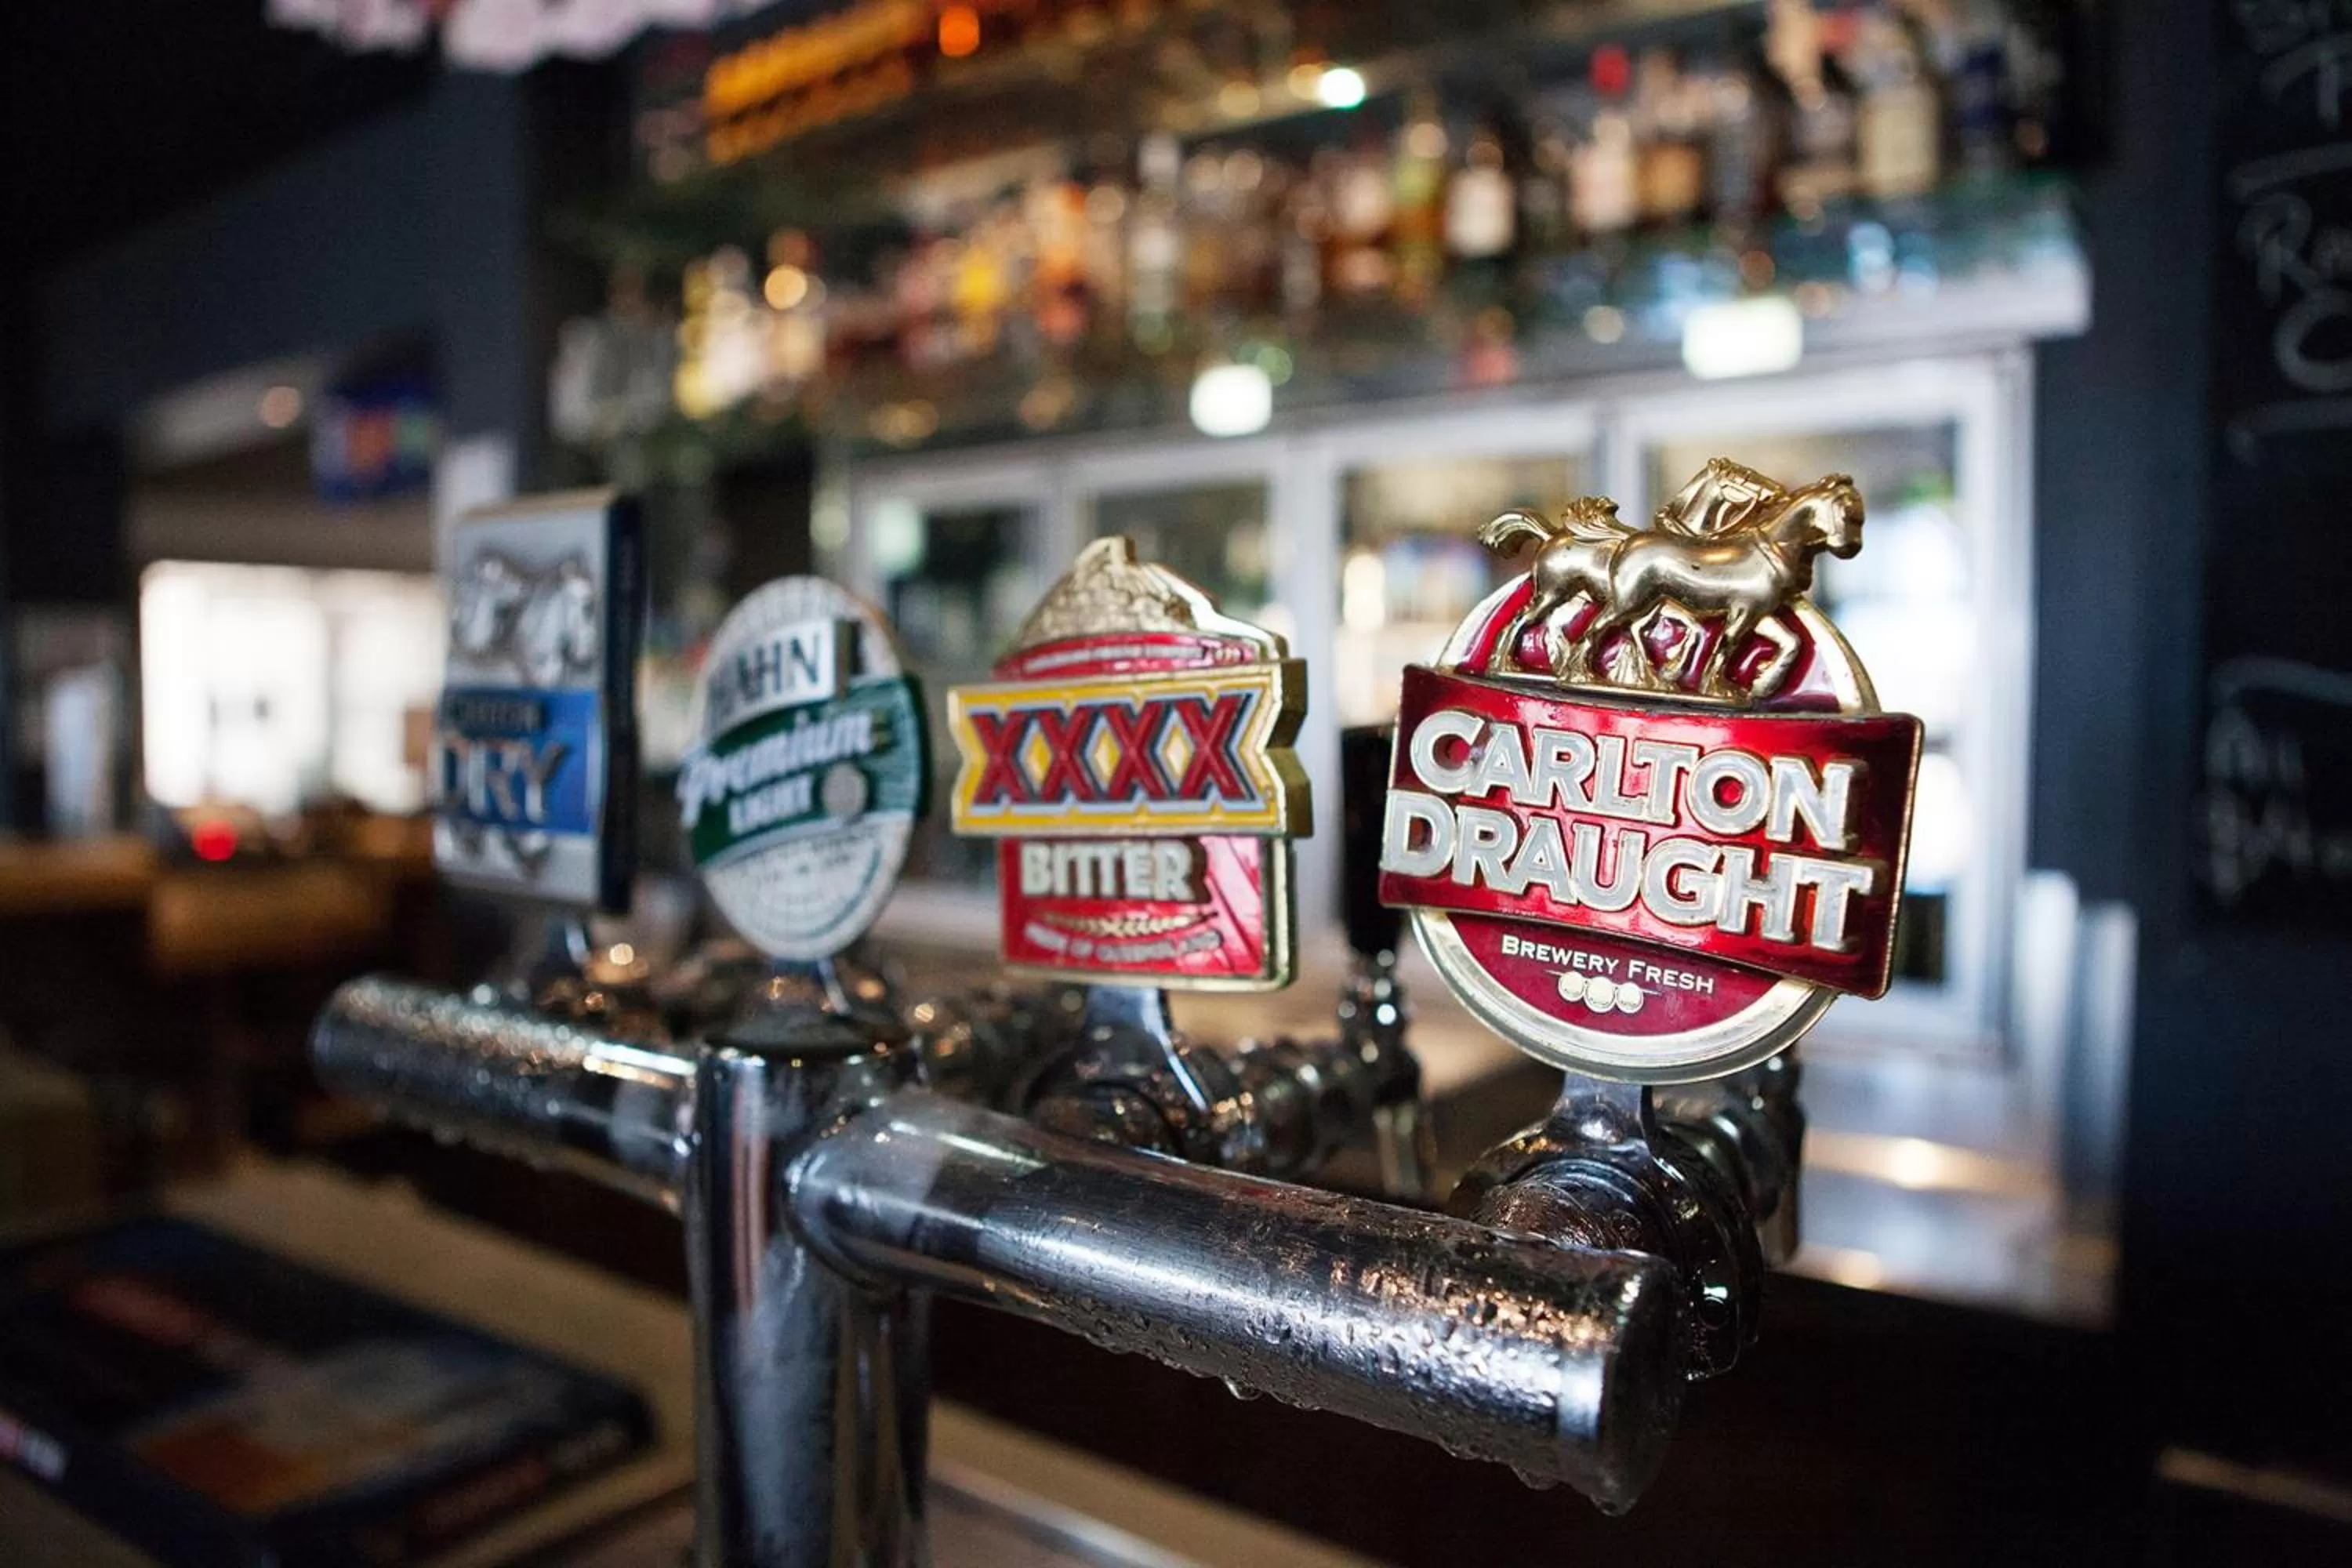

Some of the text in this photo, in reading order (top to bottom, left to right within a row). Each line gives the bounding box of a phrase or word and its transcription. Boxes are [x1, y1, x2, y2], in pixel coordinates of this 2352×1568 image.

[969, 693, 1256, 805] XXXX
[1410, 710, 1857, 851] CARLTON
[1021, 840, 1195, 901] BITTER
[1380, 789, 1874, 953] DRAUGHT
[1501, 934, 1715, 994] BREWERY FRESH
